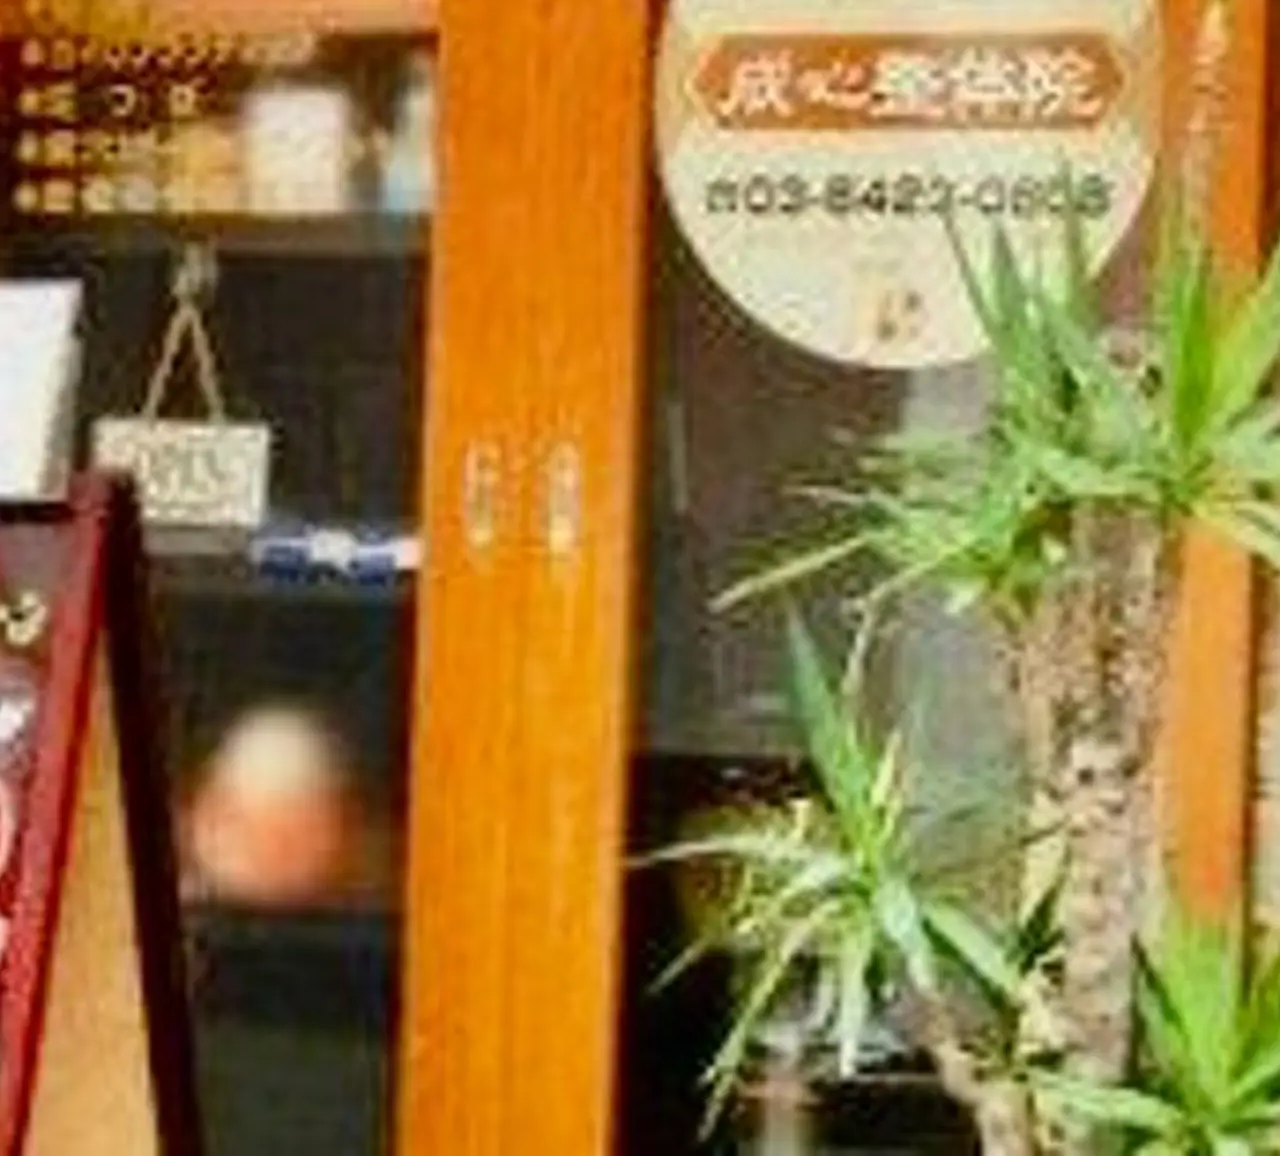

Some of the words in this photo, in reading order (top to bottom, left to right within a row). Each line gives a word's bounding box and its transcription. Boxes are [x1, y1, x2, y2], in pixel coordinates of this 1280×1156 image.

[720, 44, 1106, 120] 成心整体院
